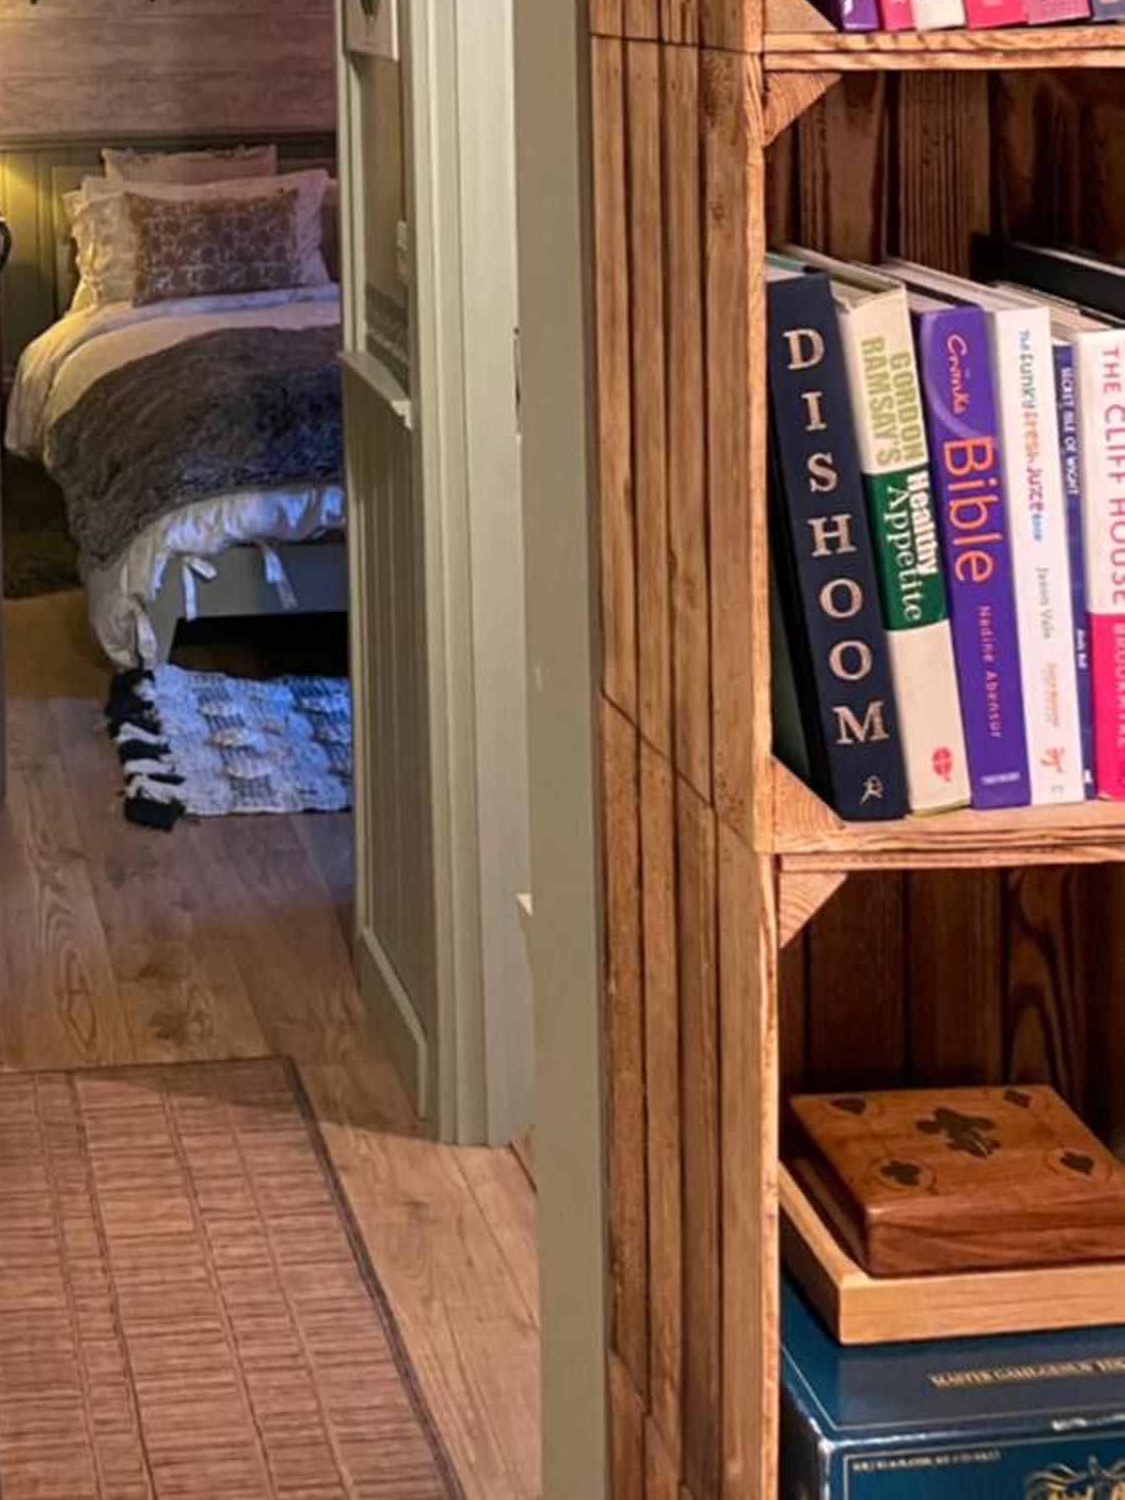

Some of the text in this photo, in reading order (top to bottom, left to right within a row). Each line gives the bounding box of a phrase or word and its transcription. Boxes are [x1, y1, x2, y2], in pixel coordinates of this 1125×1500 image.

[861, 337, 901, 466] RAMSAY'S
[890, 352, 924, 460] GORDON
[1019, 354, 1035, 410] funky
[1023, 411, 1039, 464] fresh
[1063, 435, 1077, 452] OF
[1065, 456, 1079, 494] WIGHT
[1102, 346, 1125, 605] THE CLIFF HOUSE
[783, 330, 889, 741] DISHOOM
[883, 486, 923, 621] Appetite
[906, 470, 939, 575] Healthy
[943, 436, 1004, 582] Bible
[979, 606, 1001, 738] Nadine Abensur
